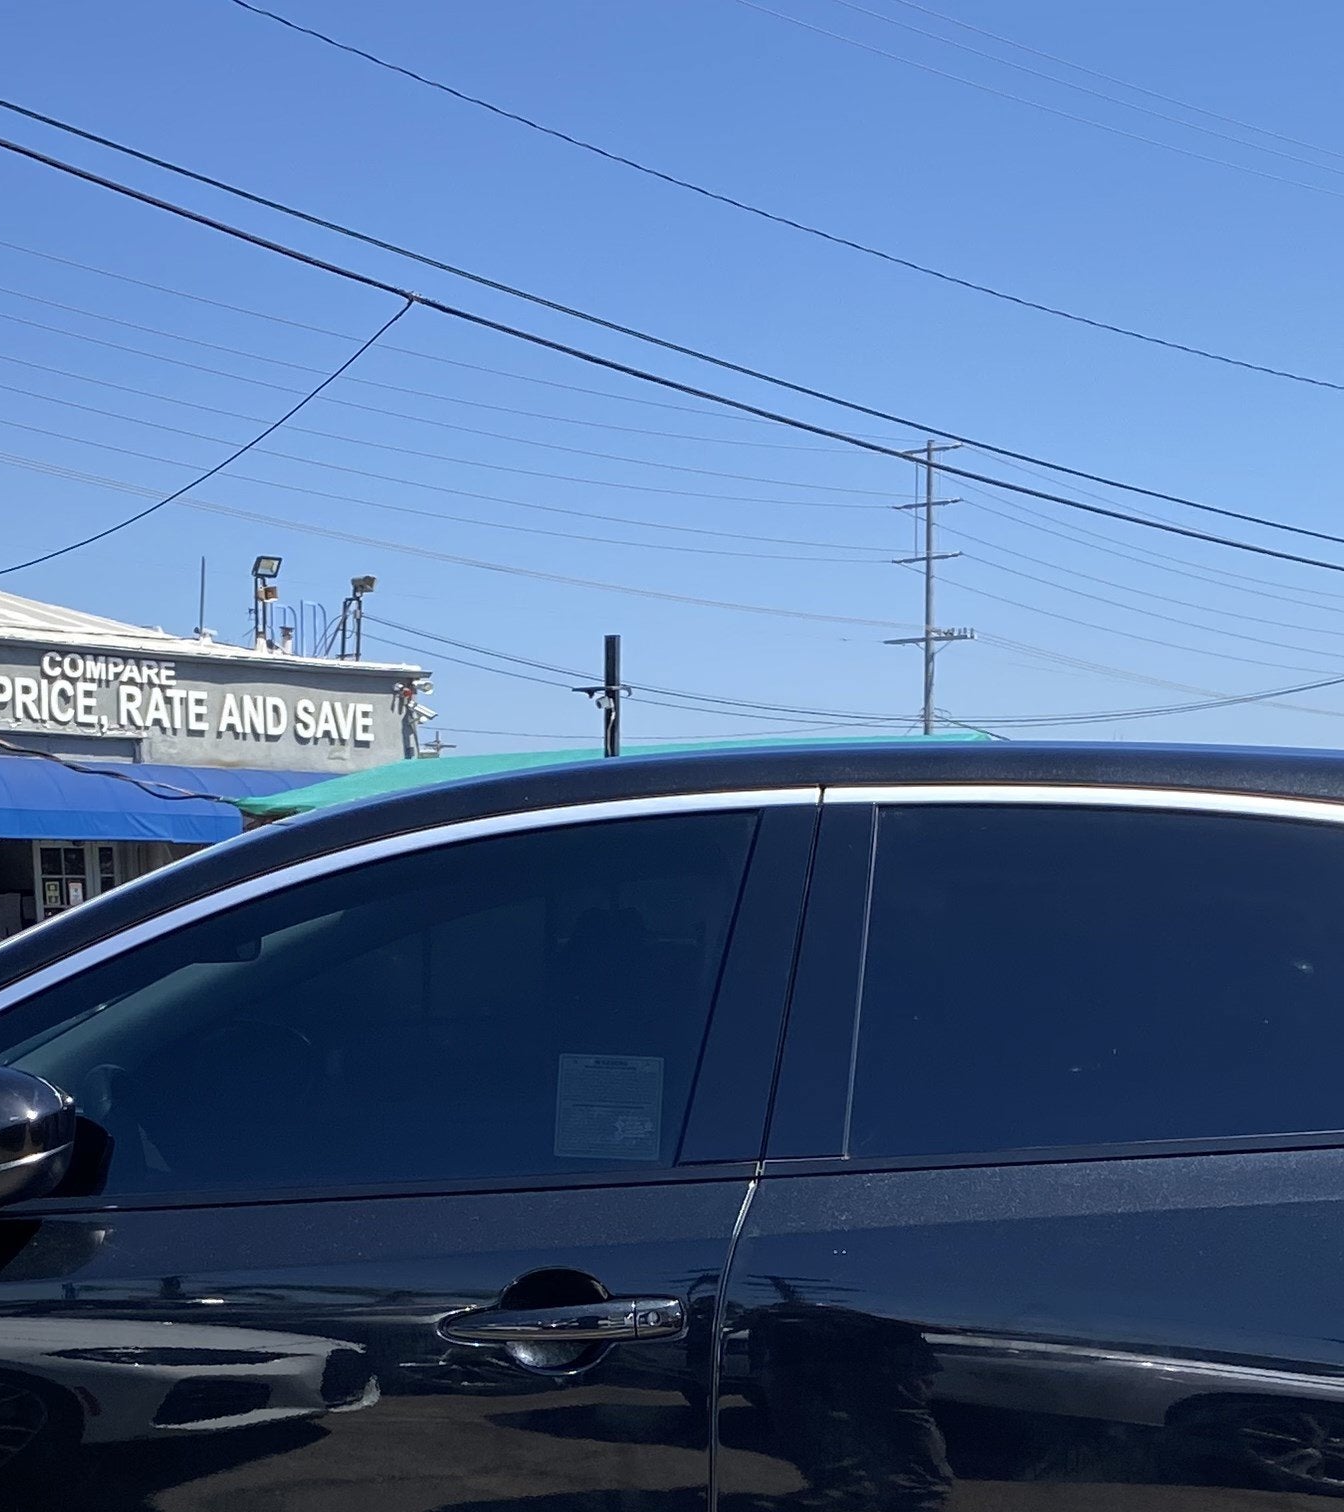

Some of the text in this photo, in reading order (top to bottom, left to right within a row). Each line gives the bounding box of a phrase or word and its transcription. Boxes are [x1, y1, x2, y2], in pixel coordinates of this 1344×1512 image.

[41, 651, 177, 686] COMPARE
[118, 684, 209, 731] RATE
[218, 692, 288, 736] AND
[295, 698, 375, 742] SAVE
